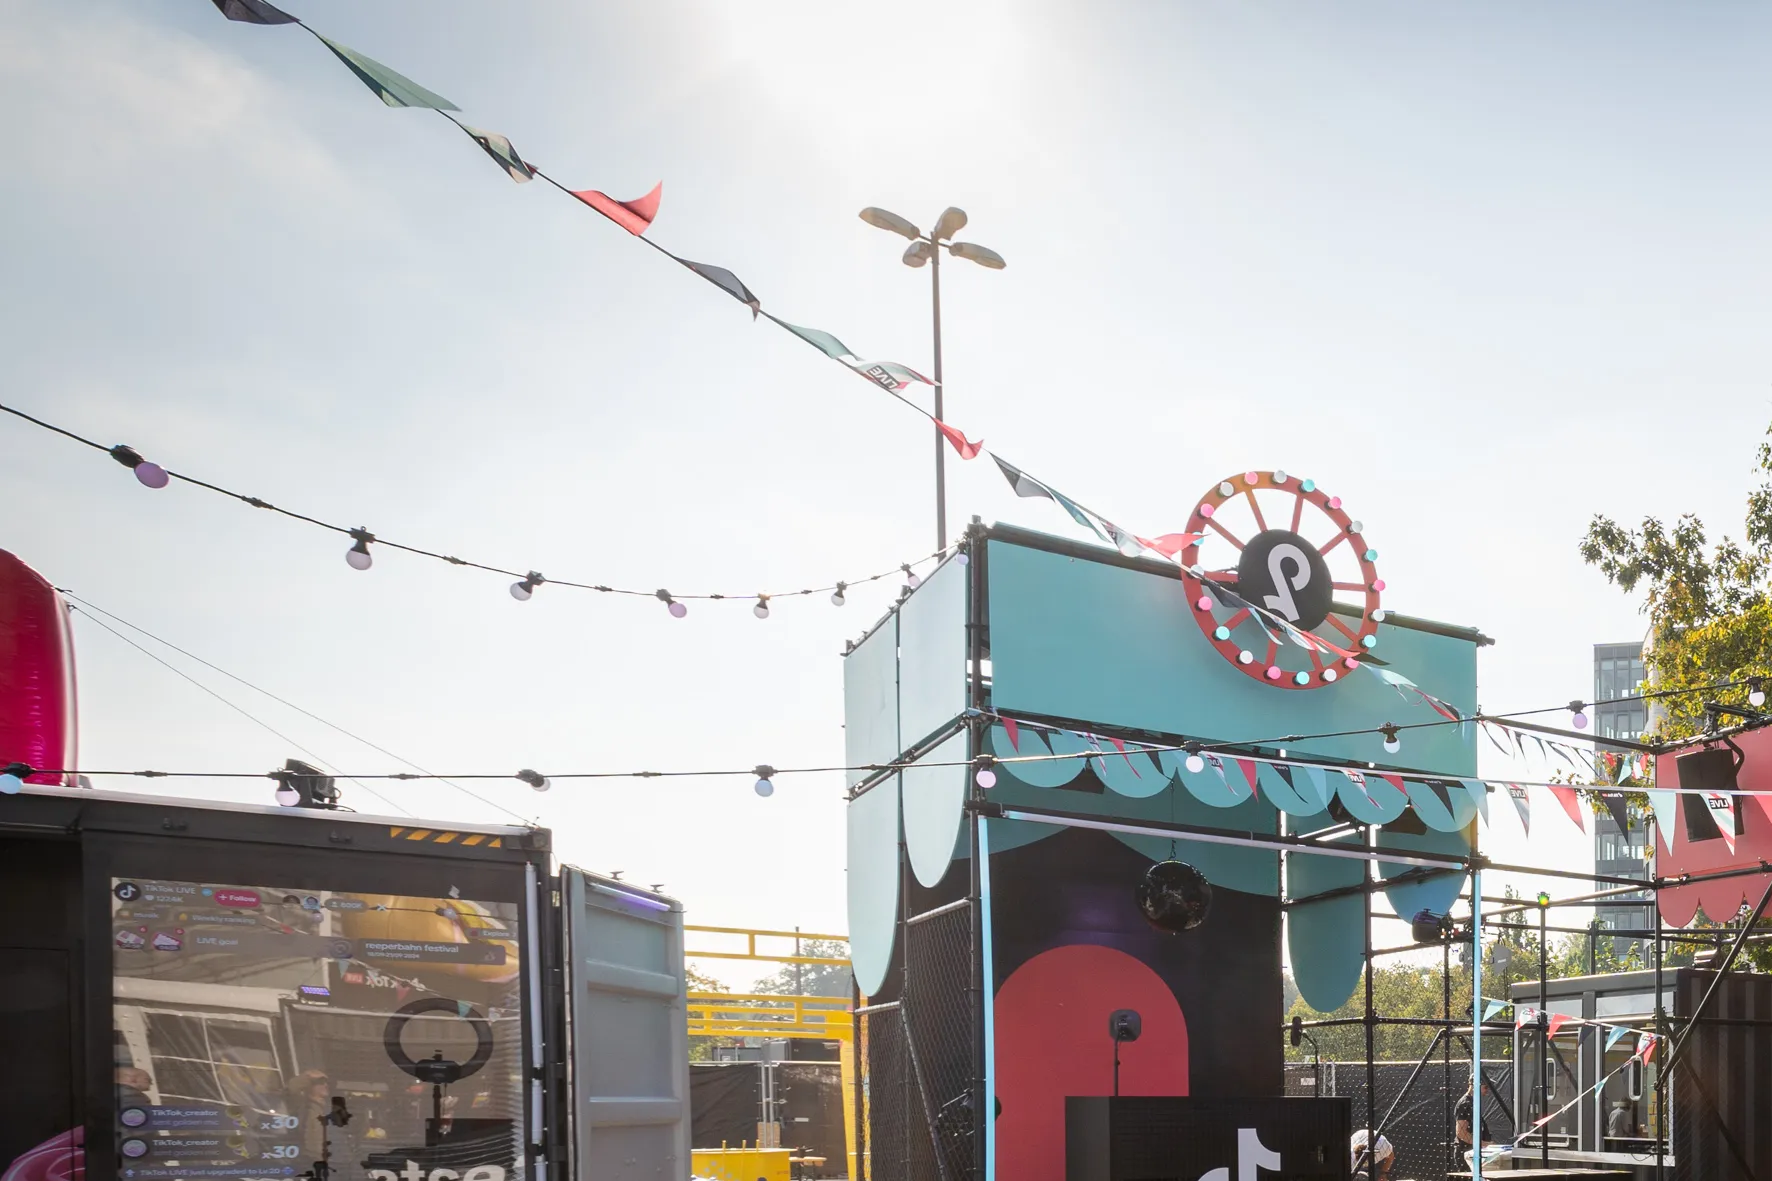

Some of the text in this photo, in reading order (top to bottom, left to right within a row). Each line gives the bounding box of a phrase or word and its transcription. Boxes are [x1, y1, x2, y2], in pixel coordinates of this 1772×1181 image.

[145, 884, 196, 895] TikTok LIVE
[229, 894, 257, 903] Follow
[197, 937, 239, 946] LIVE goal
[366, 942, 459, 953] reeperbahn festival
[152, 1109, 219, 1117] TikTok_creator
[261, 1116, 299, 1130] x30
[152, 1139, 219, 1147] TikTok_creator
[261, 1145, 300, 1159] x30
[140, 1169, 168, 1177] TikTok
[206, 1168, 247, 1177] upgraded
